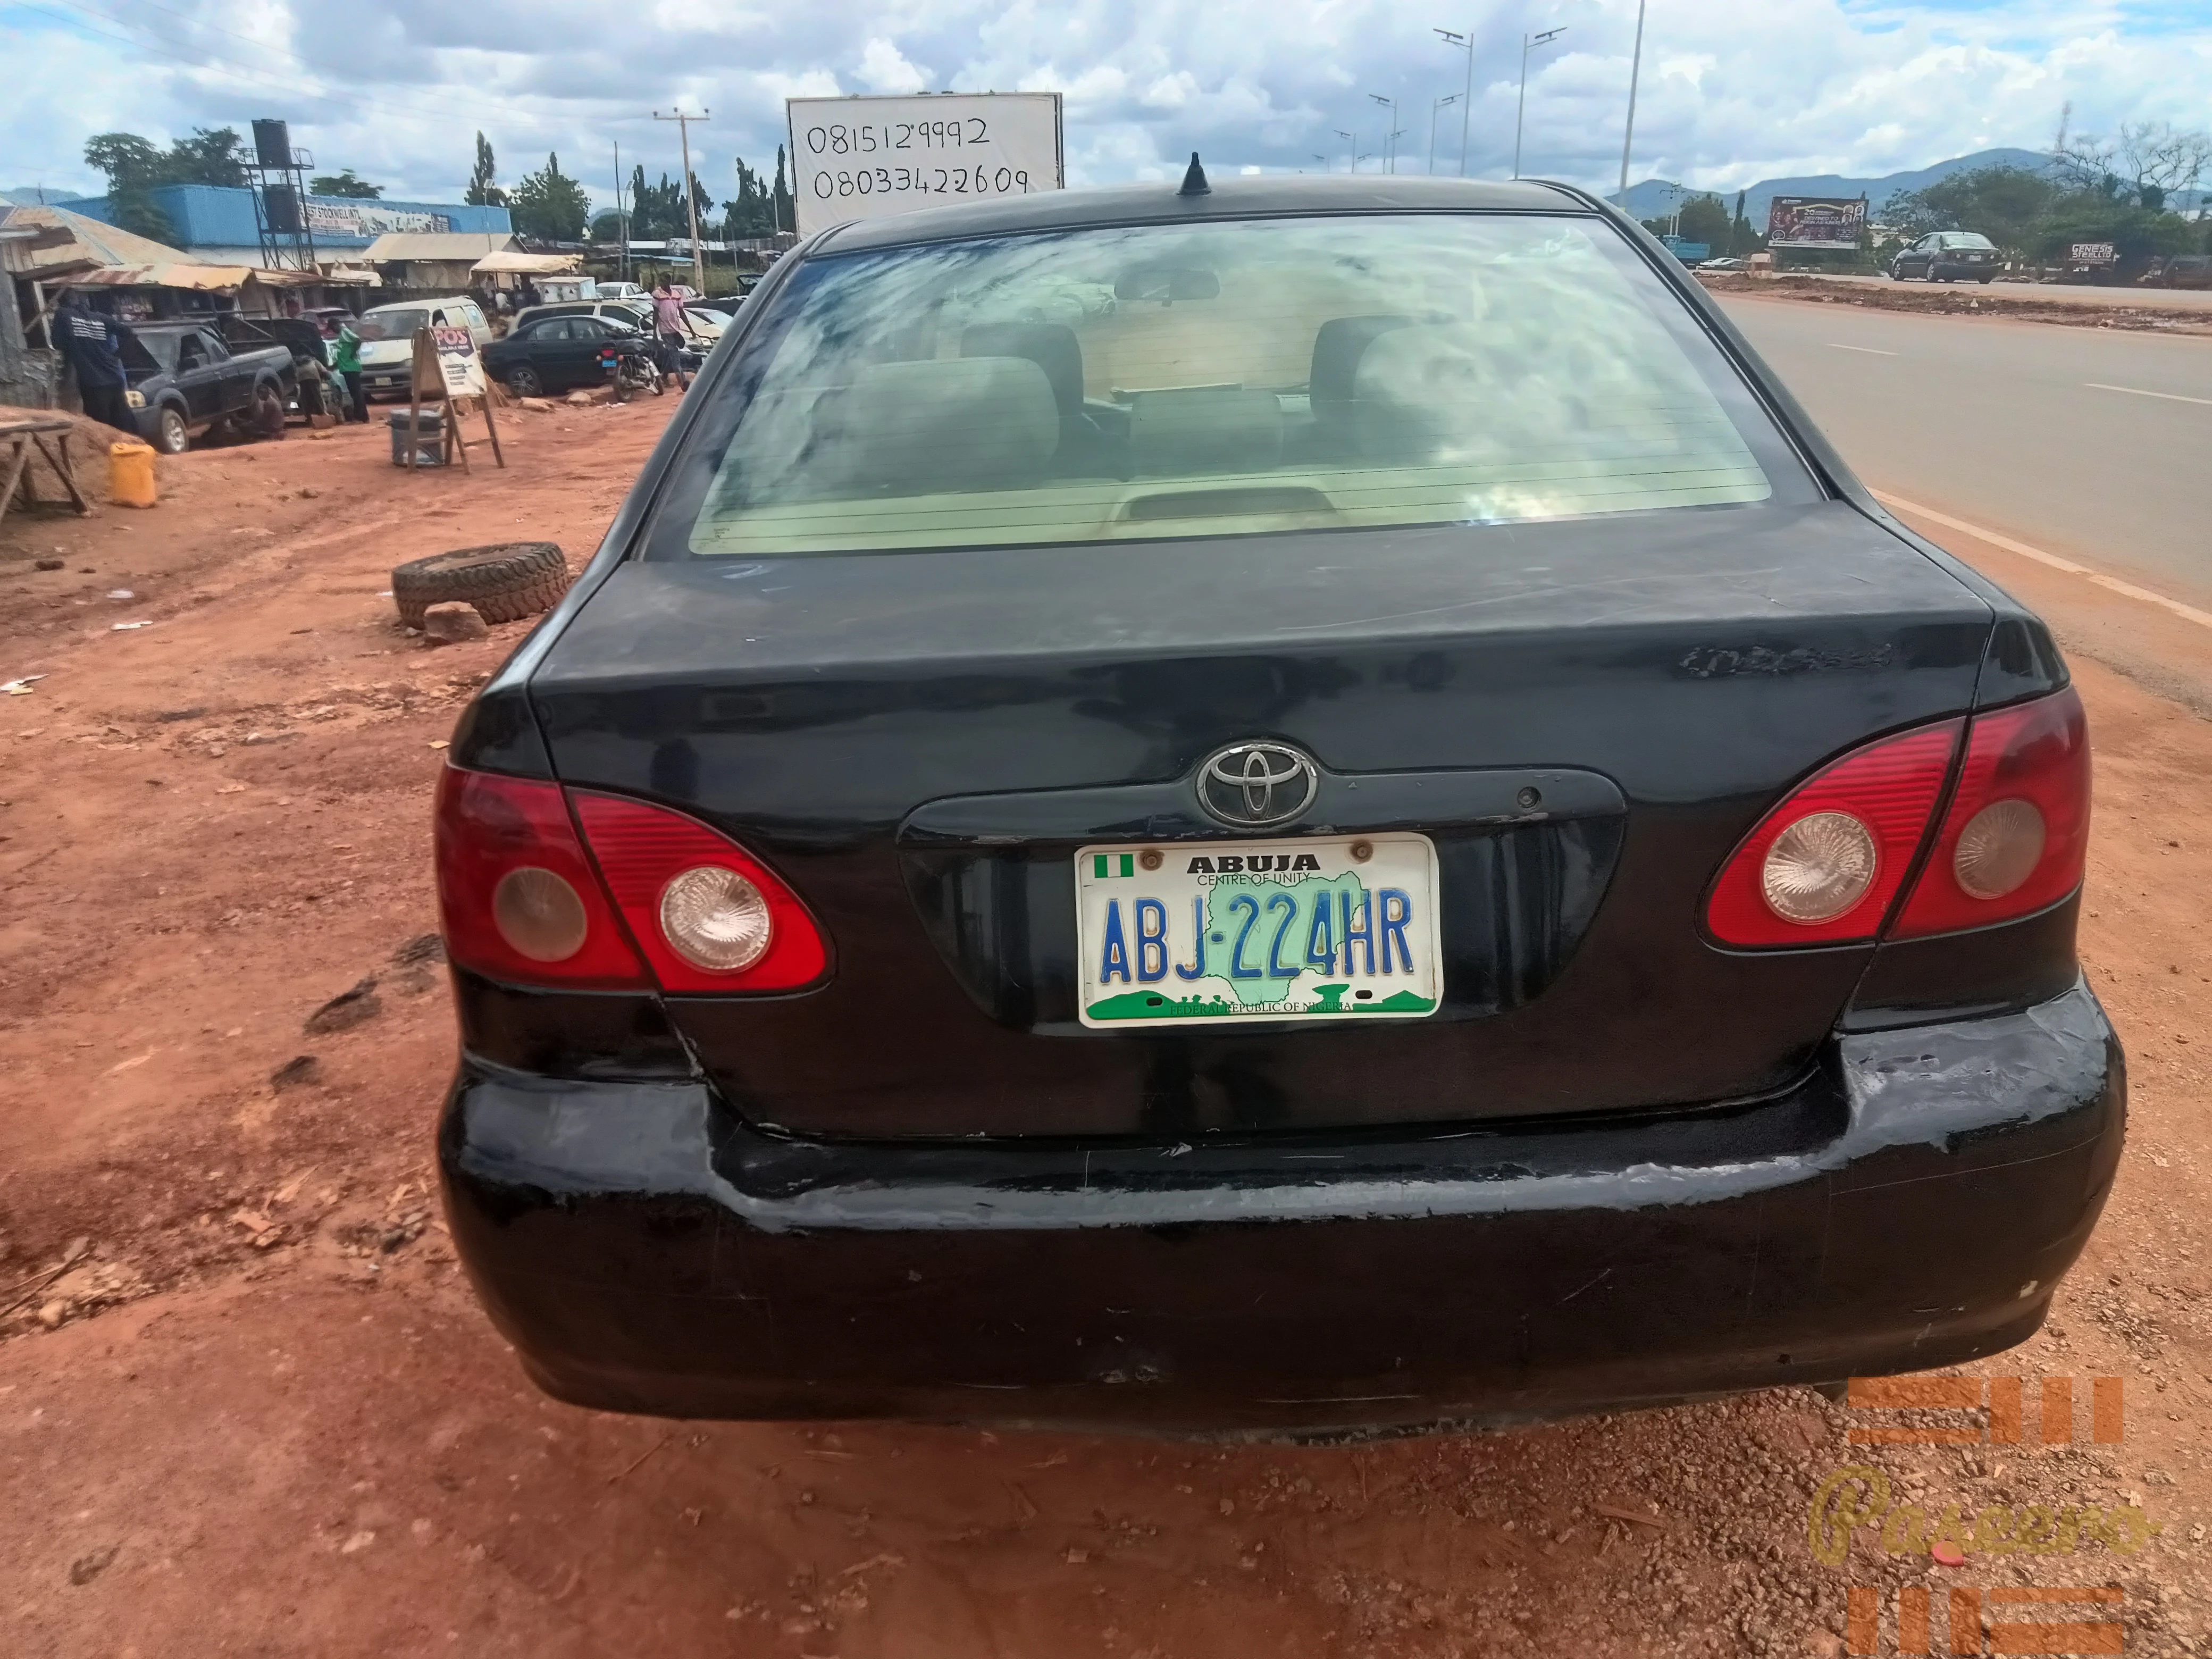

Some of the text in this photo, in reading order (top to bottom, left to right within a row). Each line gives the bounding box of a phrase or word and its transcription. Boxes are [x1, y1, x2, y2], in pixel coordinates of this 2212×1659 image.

[808, 118, 990, 153] 0815129992
[815, 164, 1028, 198] 08033422609
[2072, 244, 2113, 253] GENESIS
[434, 330, 467, 346] POS
[1187, 854, 1320, 874] ABUJA
[1197, 872, 1310, 886] CENTRE OF UNITY
[1100, 889, 1414, 983] ABJ-224HR
[1170, 1001, 1352, 1016] FEDERAL REPUBLIC OF NIGERIA
